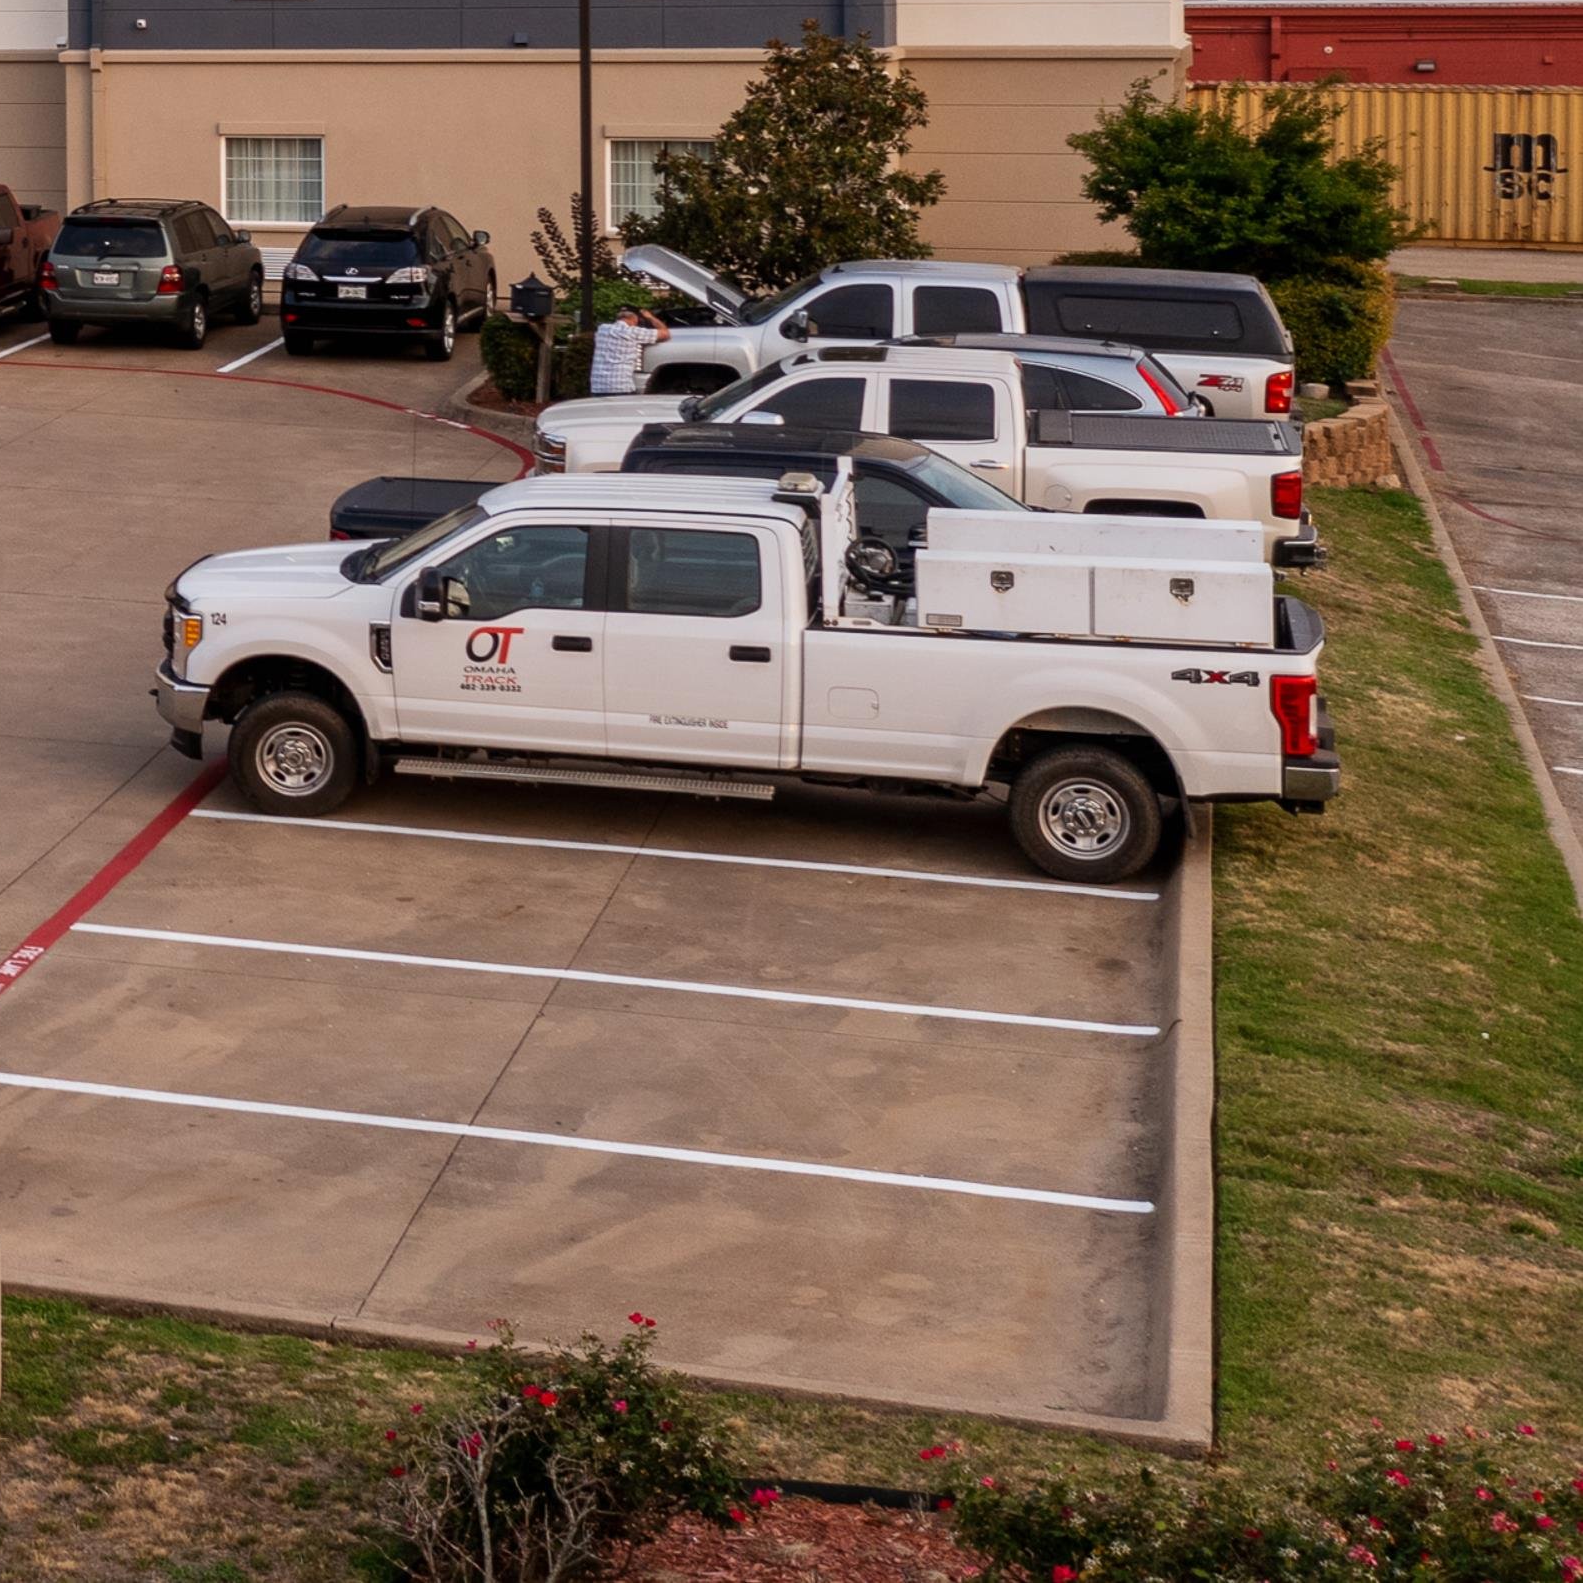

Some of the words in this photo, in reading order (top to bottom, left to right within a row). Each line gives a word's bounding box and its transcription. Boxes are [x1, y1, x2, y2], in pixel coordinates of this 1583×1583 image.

[465, 626, 525, 665] OT
[463, 666, 516, 675] OMAHA
[463, 674, 518, 685] TRACK
